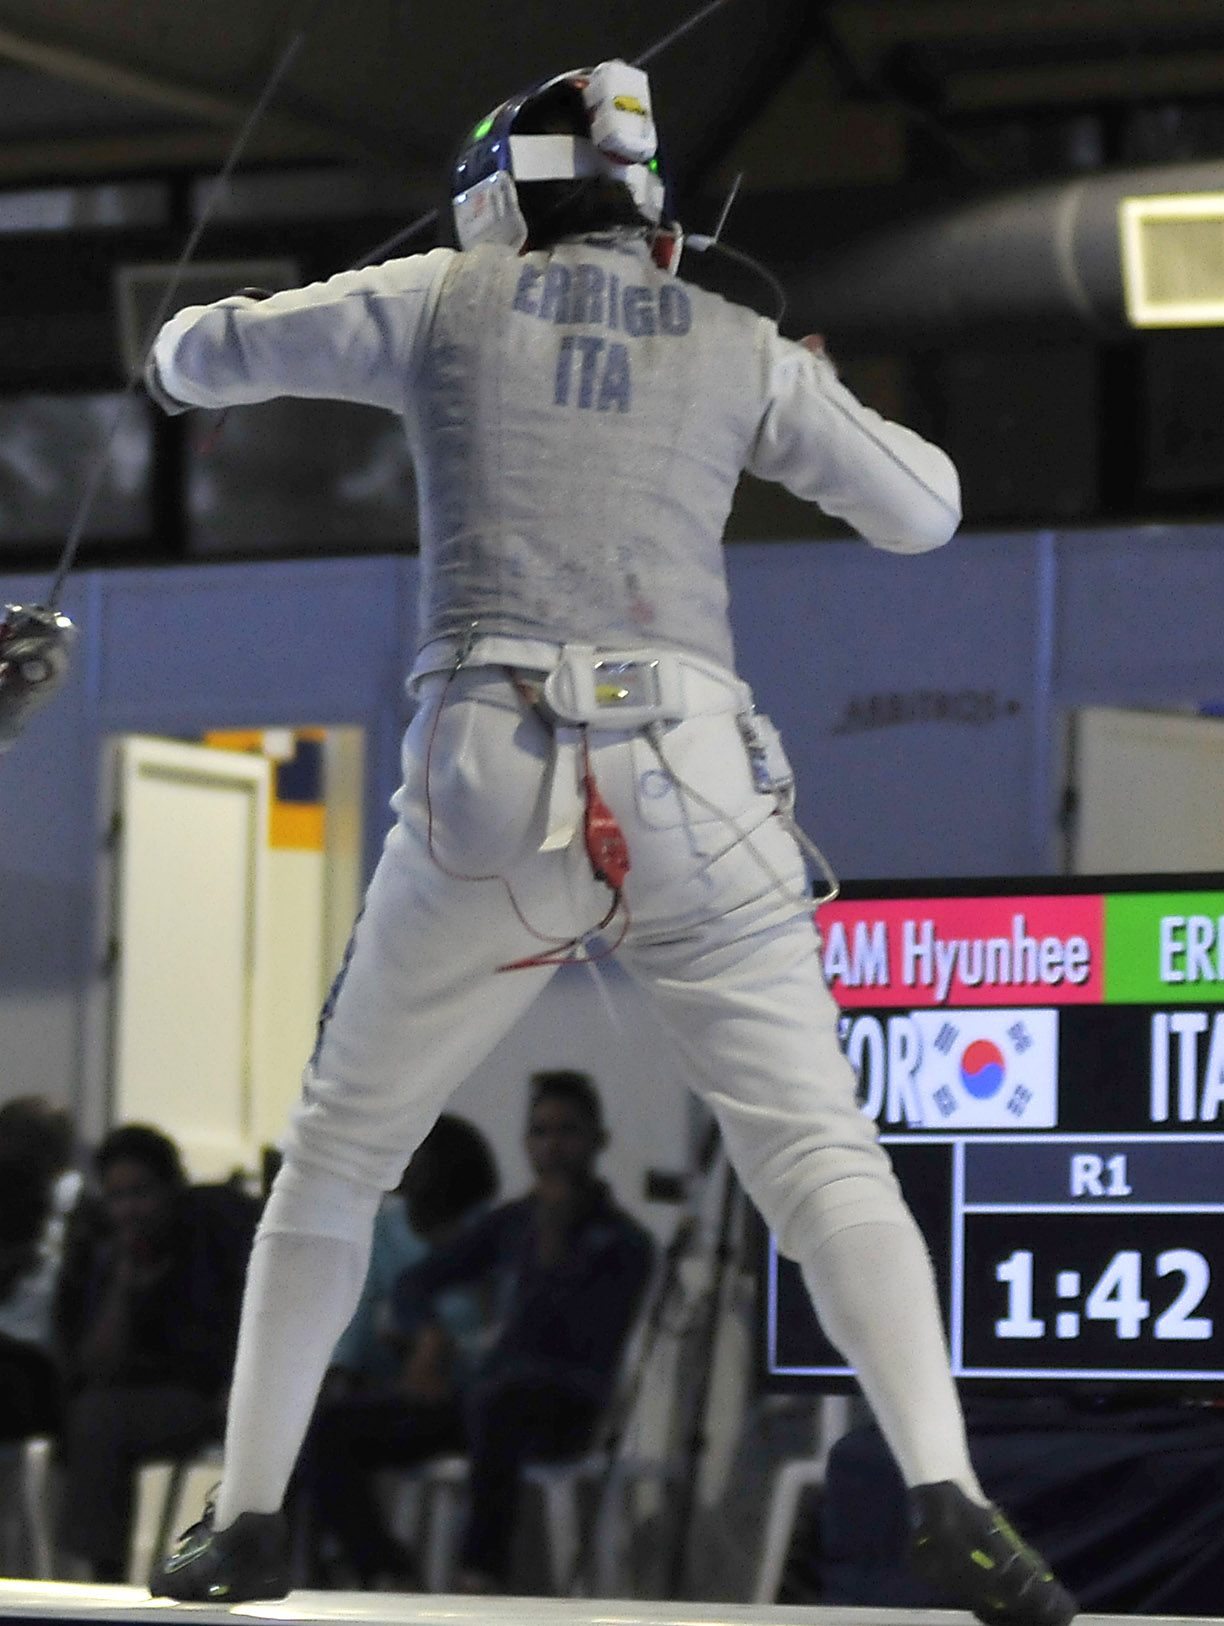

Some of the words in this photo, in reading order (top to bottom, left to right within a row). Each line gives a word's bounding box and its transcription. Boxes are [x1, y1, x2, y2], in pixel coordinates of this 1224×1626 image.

[512, 263, 692, 337] ERRIGO
[554, 336, 632, 412] ITA
[901, 913, 1091, 1002] Hyunhee
[1160, 915, 1224, 982] ER
[838, 1015, 922, 1124] OR
[1070, 1153, 1133, 1197] R1
[994, 1249, 1214, 1341] 1:42
